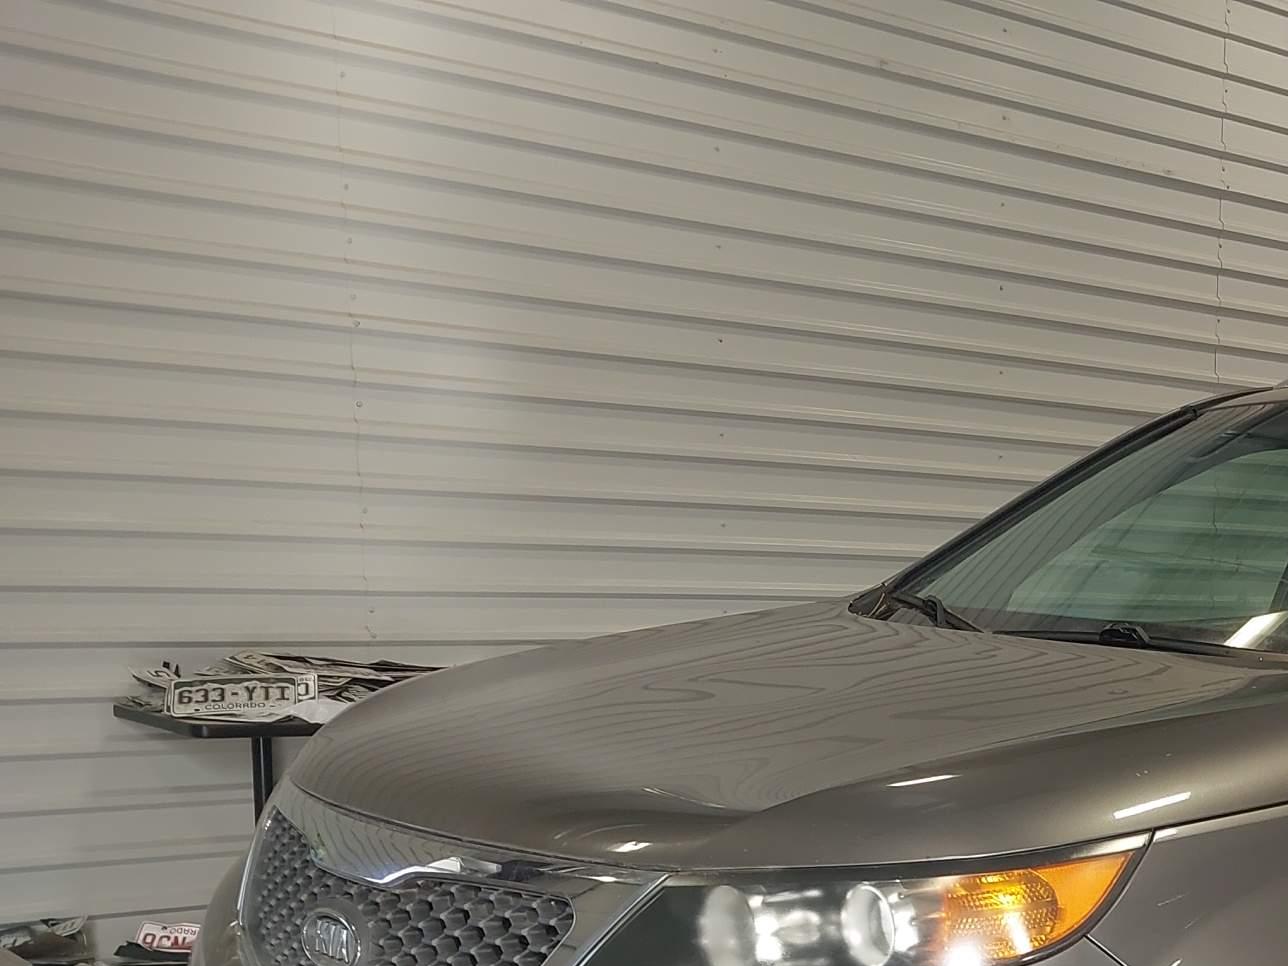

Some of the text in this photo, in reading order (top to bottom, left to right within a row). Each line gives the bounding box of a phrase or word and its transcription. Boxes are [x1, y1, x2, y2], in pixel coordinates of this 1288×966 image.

[178, 685, 290, 705] 633-YTI
[204, 701, 266, 711] COLORADO
[315, 919, 350, 964] KIA
